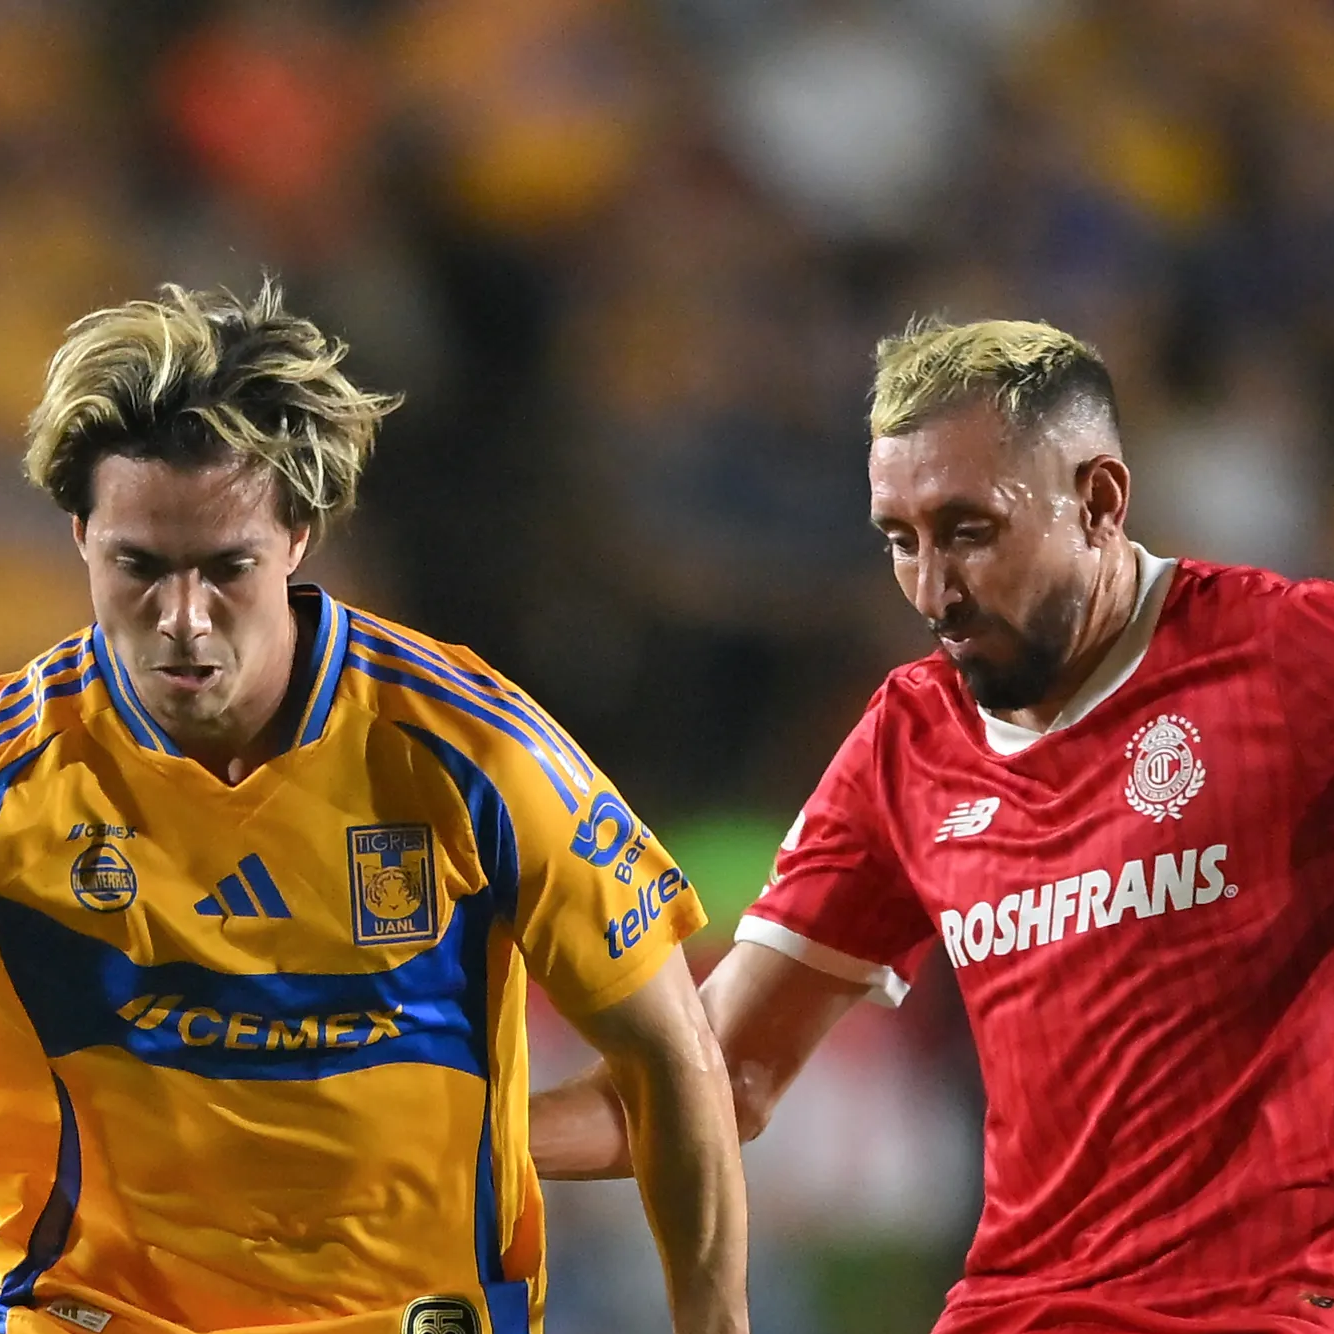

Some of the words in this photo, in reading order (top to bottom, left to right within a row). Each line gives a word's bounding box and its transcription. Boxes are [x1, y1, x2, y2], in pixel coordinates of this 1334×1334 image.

[356, 831, 424, 852] TIGRES
[374, 918, 417, 935] UANL
[177, 1003, 403, 1050] CEMEX
